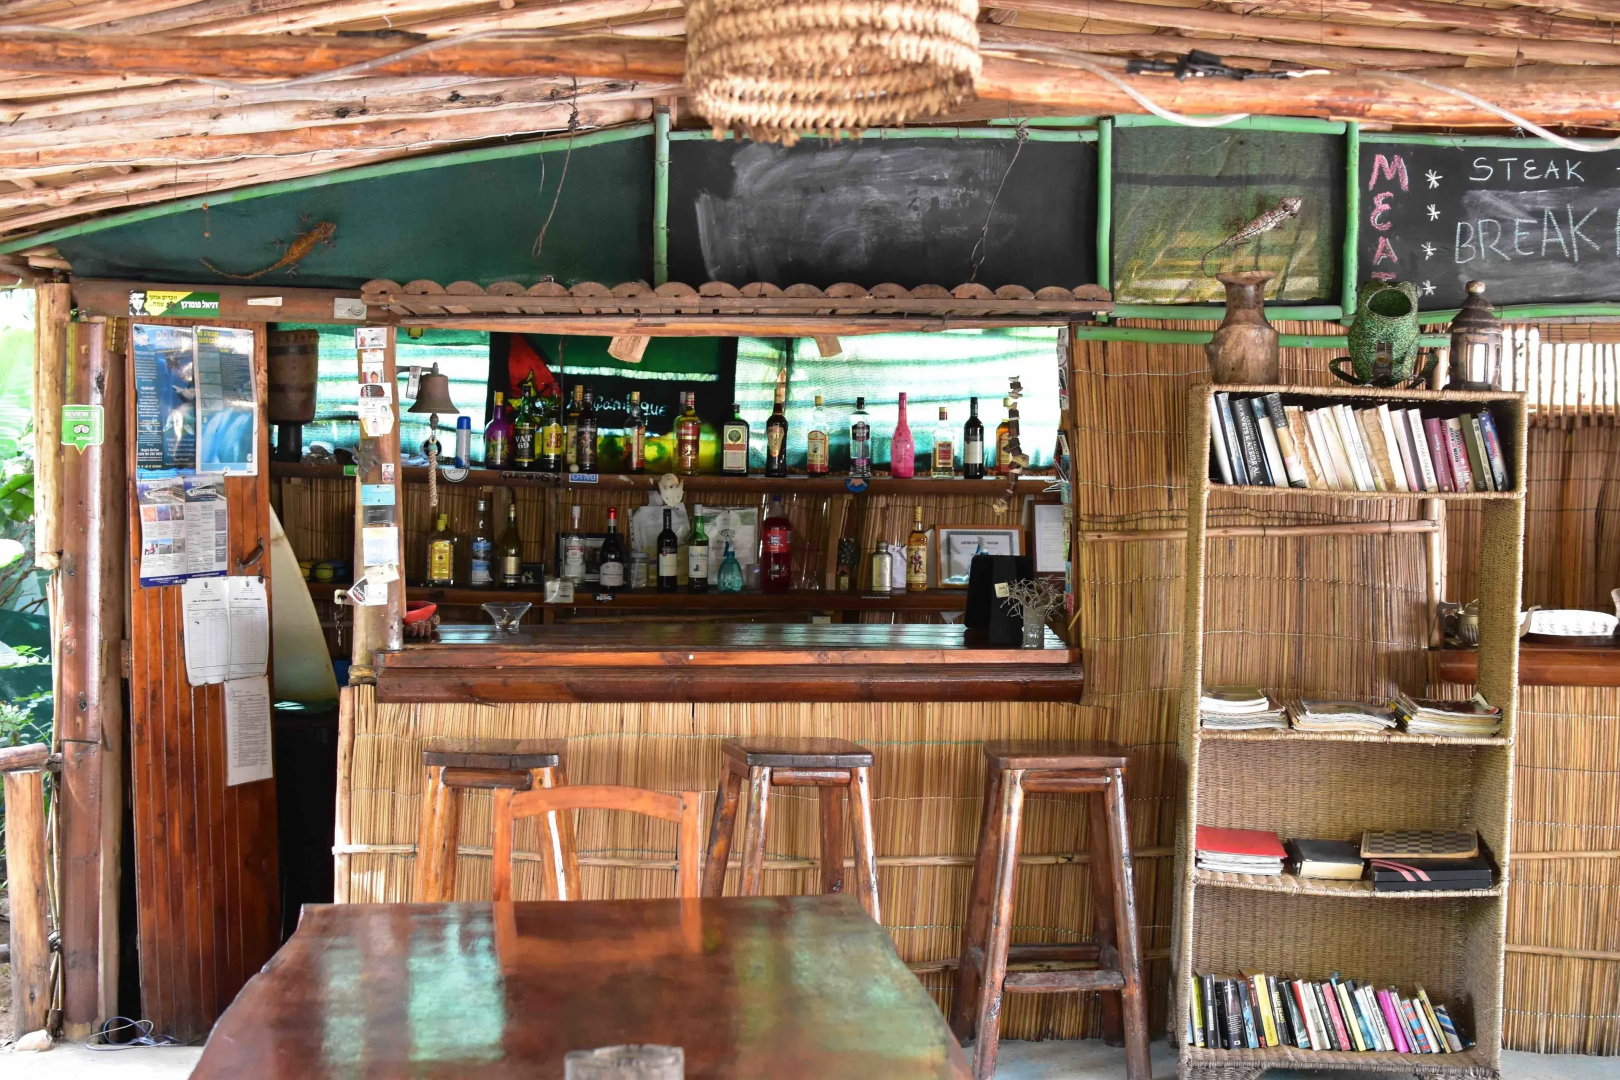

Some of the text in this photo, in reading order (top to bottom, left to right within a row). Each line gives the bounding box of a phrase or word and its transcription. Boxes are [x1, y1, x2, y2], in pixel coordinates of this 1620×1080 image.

[1469, 156, 1585, 183] STEAK
[1454, 203, 1620, 265] BREAK
[515, 434, 533, 442] VAT
[517, 441, 530, 449] 69
[545, 432, 562, 448] J&B
[1243, 433, 1260, 477] KATEDRAL
